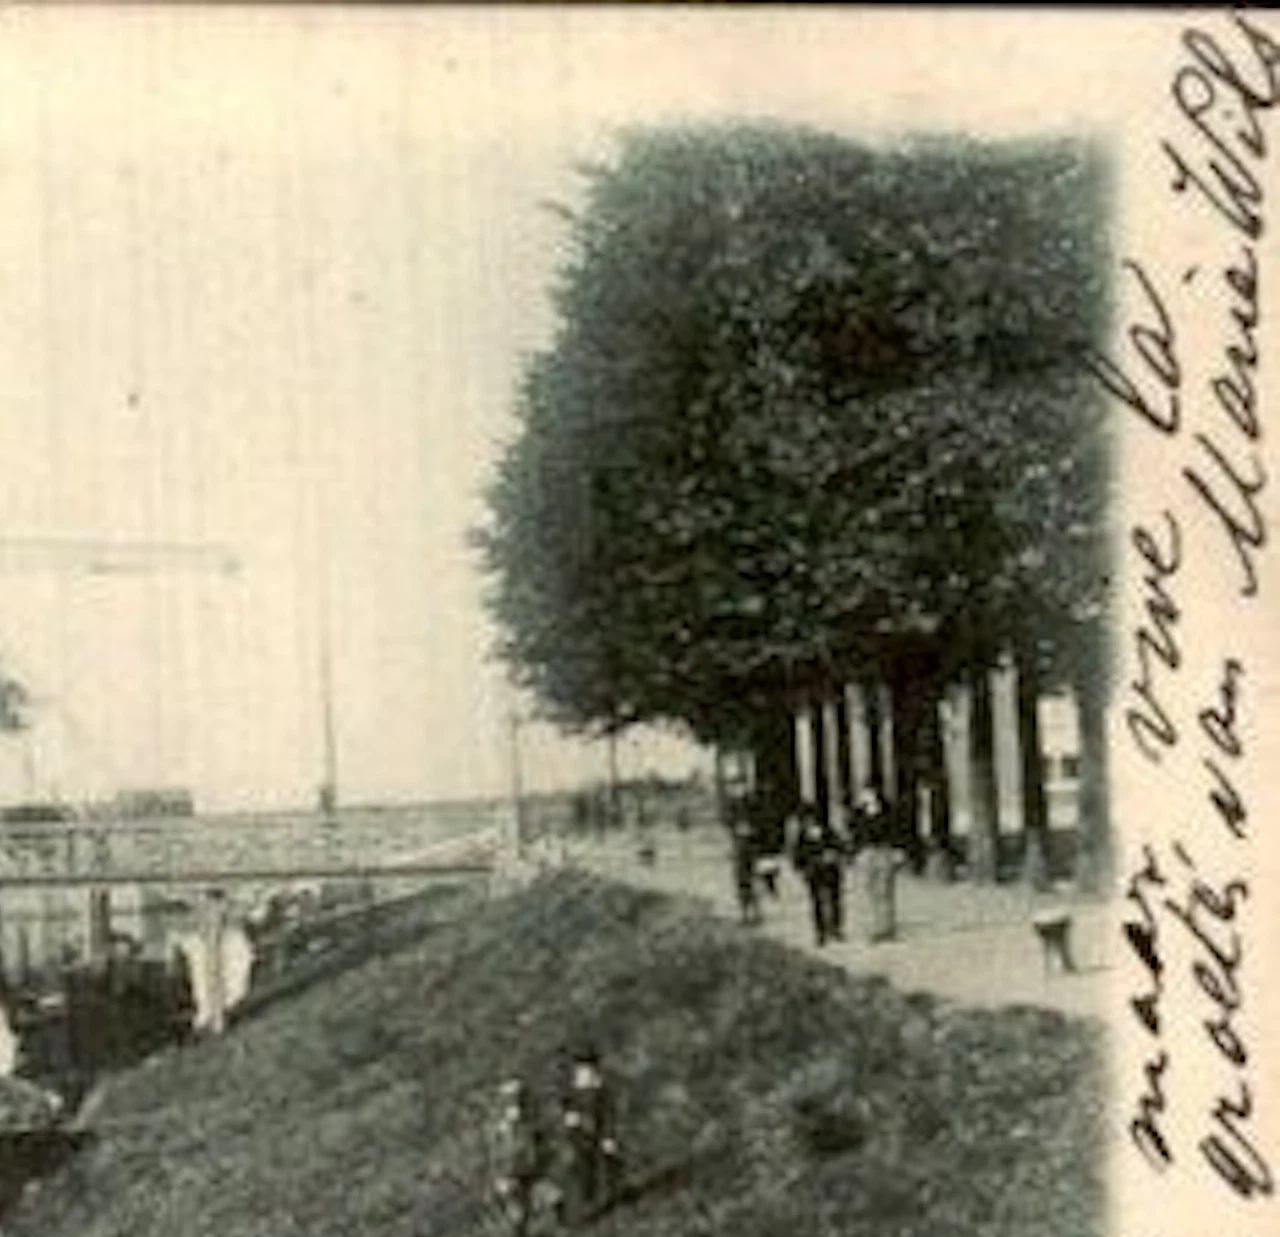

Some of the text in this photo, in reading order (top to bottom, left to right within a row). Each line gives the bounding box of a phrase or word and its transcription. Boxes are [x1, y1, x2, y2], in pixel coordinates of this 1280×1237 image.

[1082, 258, 1183, 436] la
[1197, 658, 1252, 838] van
[1122, 842, 1173, 1176] maar
